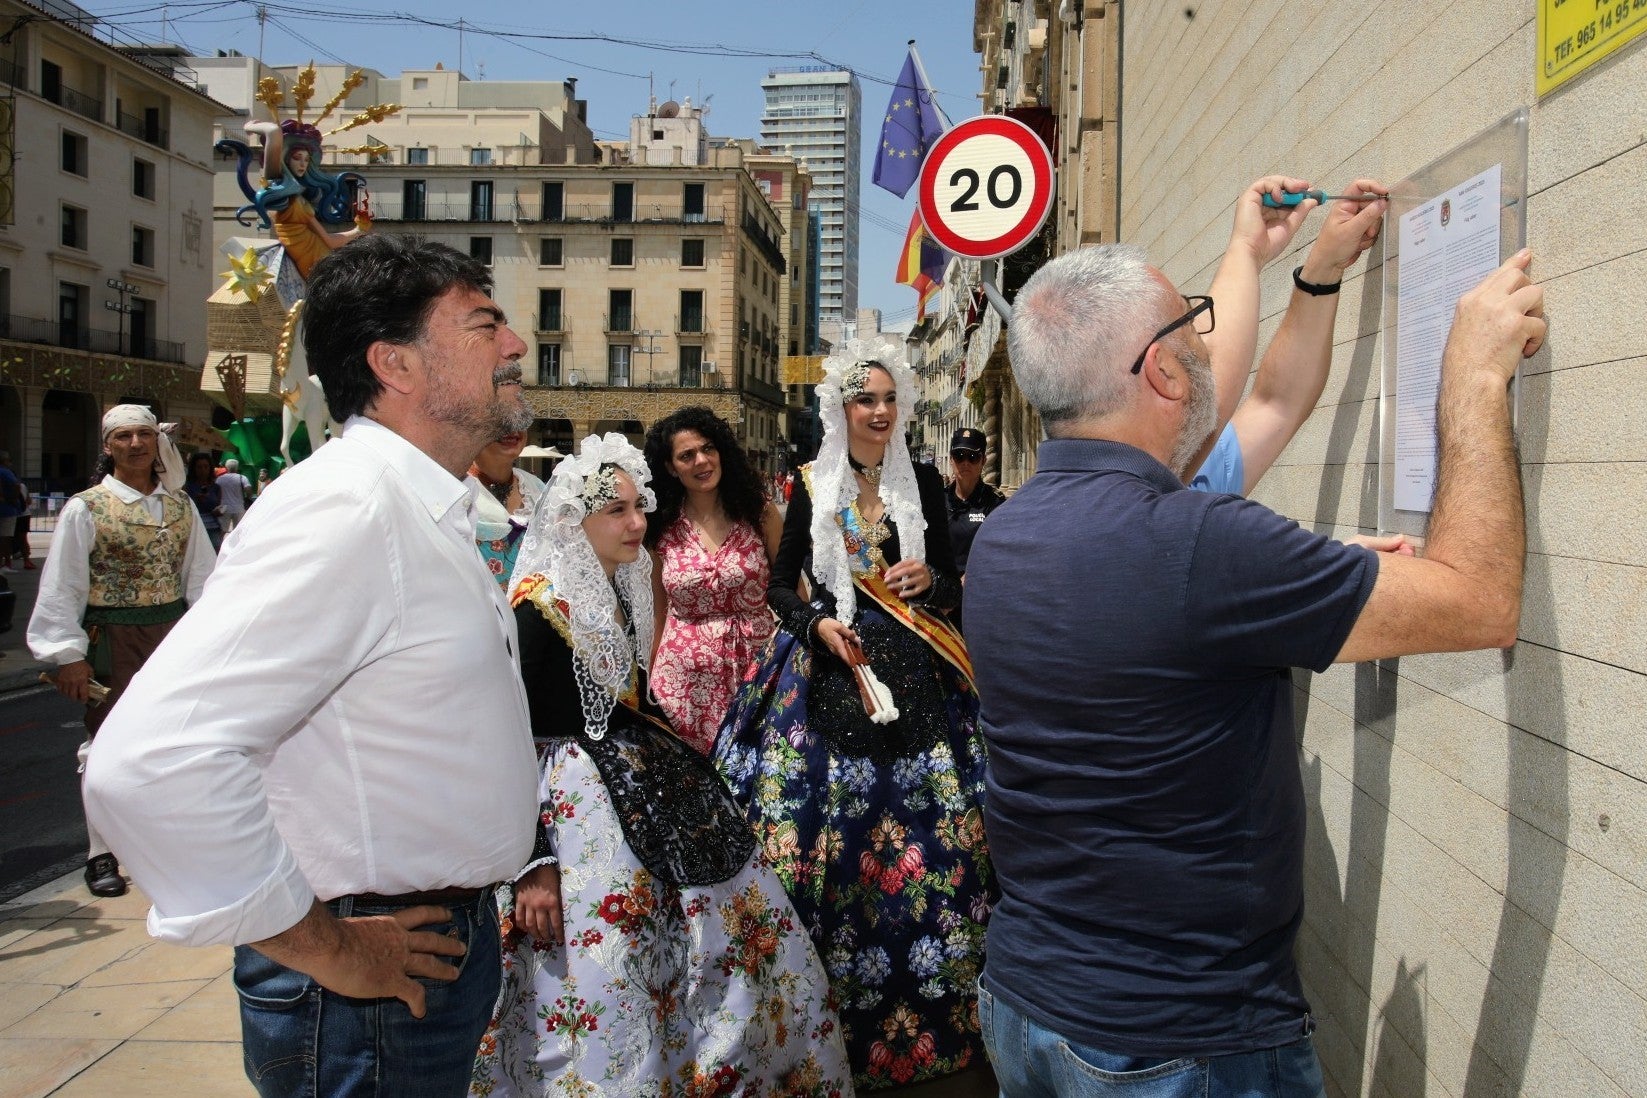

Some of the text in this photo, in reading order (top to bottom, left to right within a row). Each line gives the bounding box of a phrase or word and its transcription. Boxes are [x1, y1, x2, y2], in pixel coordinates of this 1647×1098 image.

[1555, 36, 1574, 63] TEF.
[1577, 21, 1596, 49] 965
[1599, 10, 1612, 34] 14
[1615, 0, 1629, 23] 95
[949, 164, 1022, 212] 20
